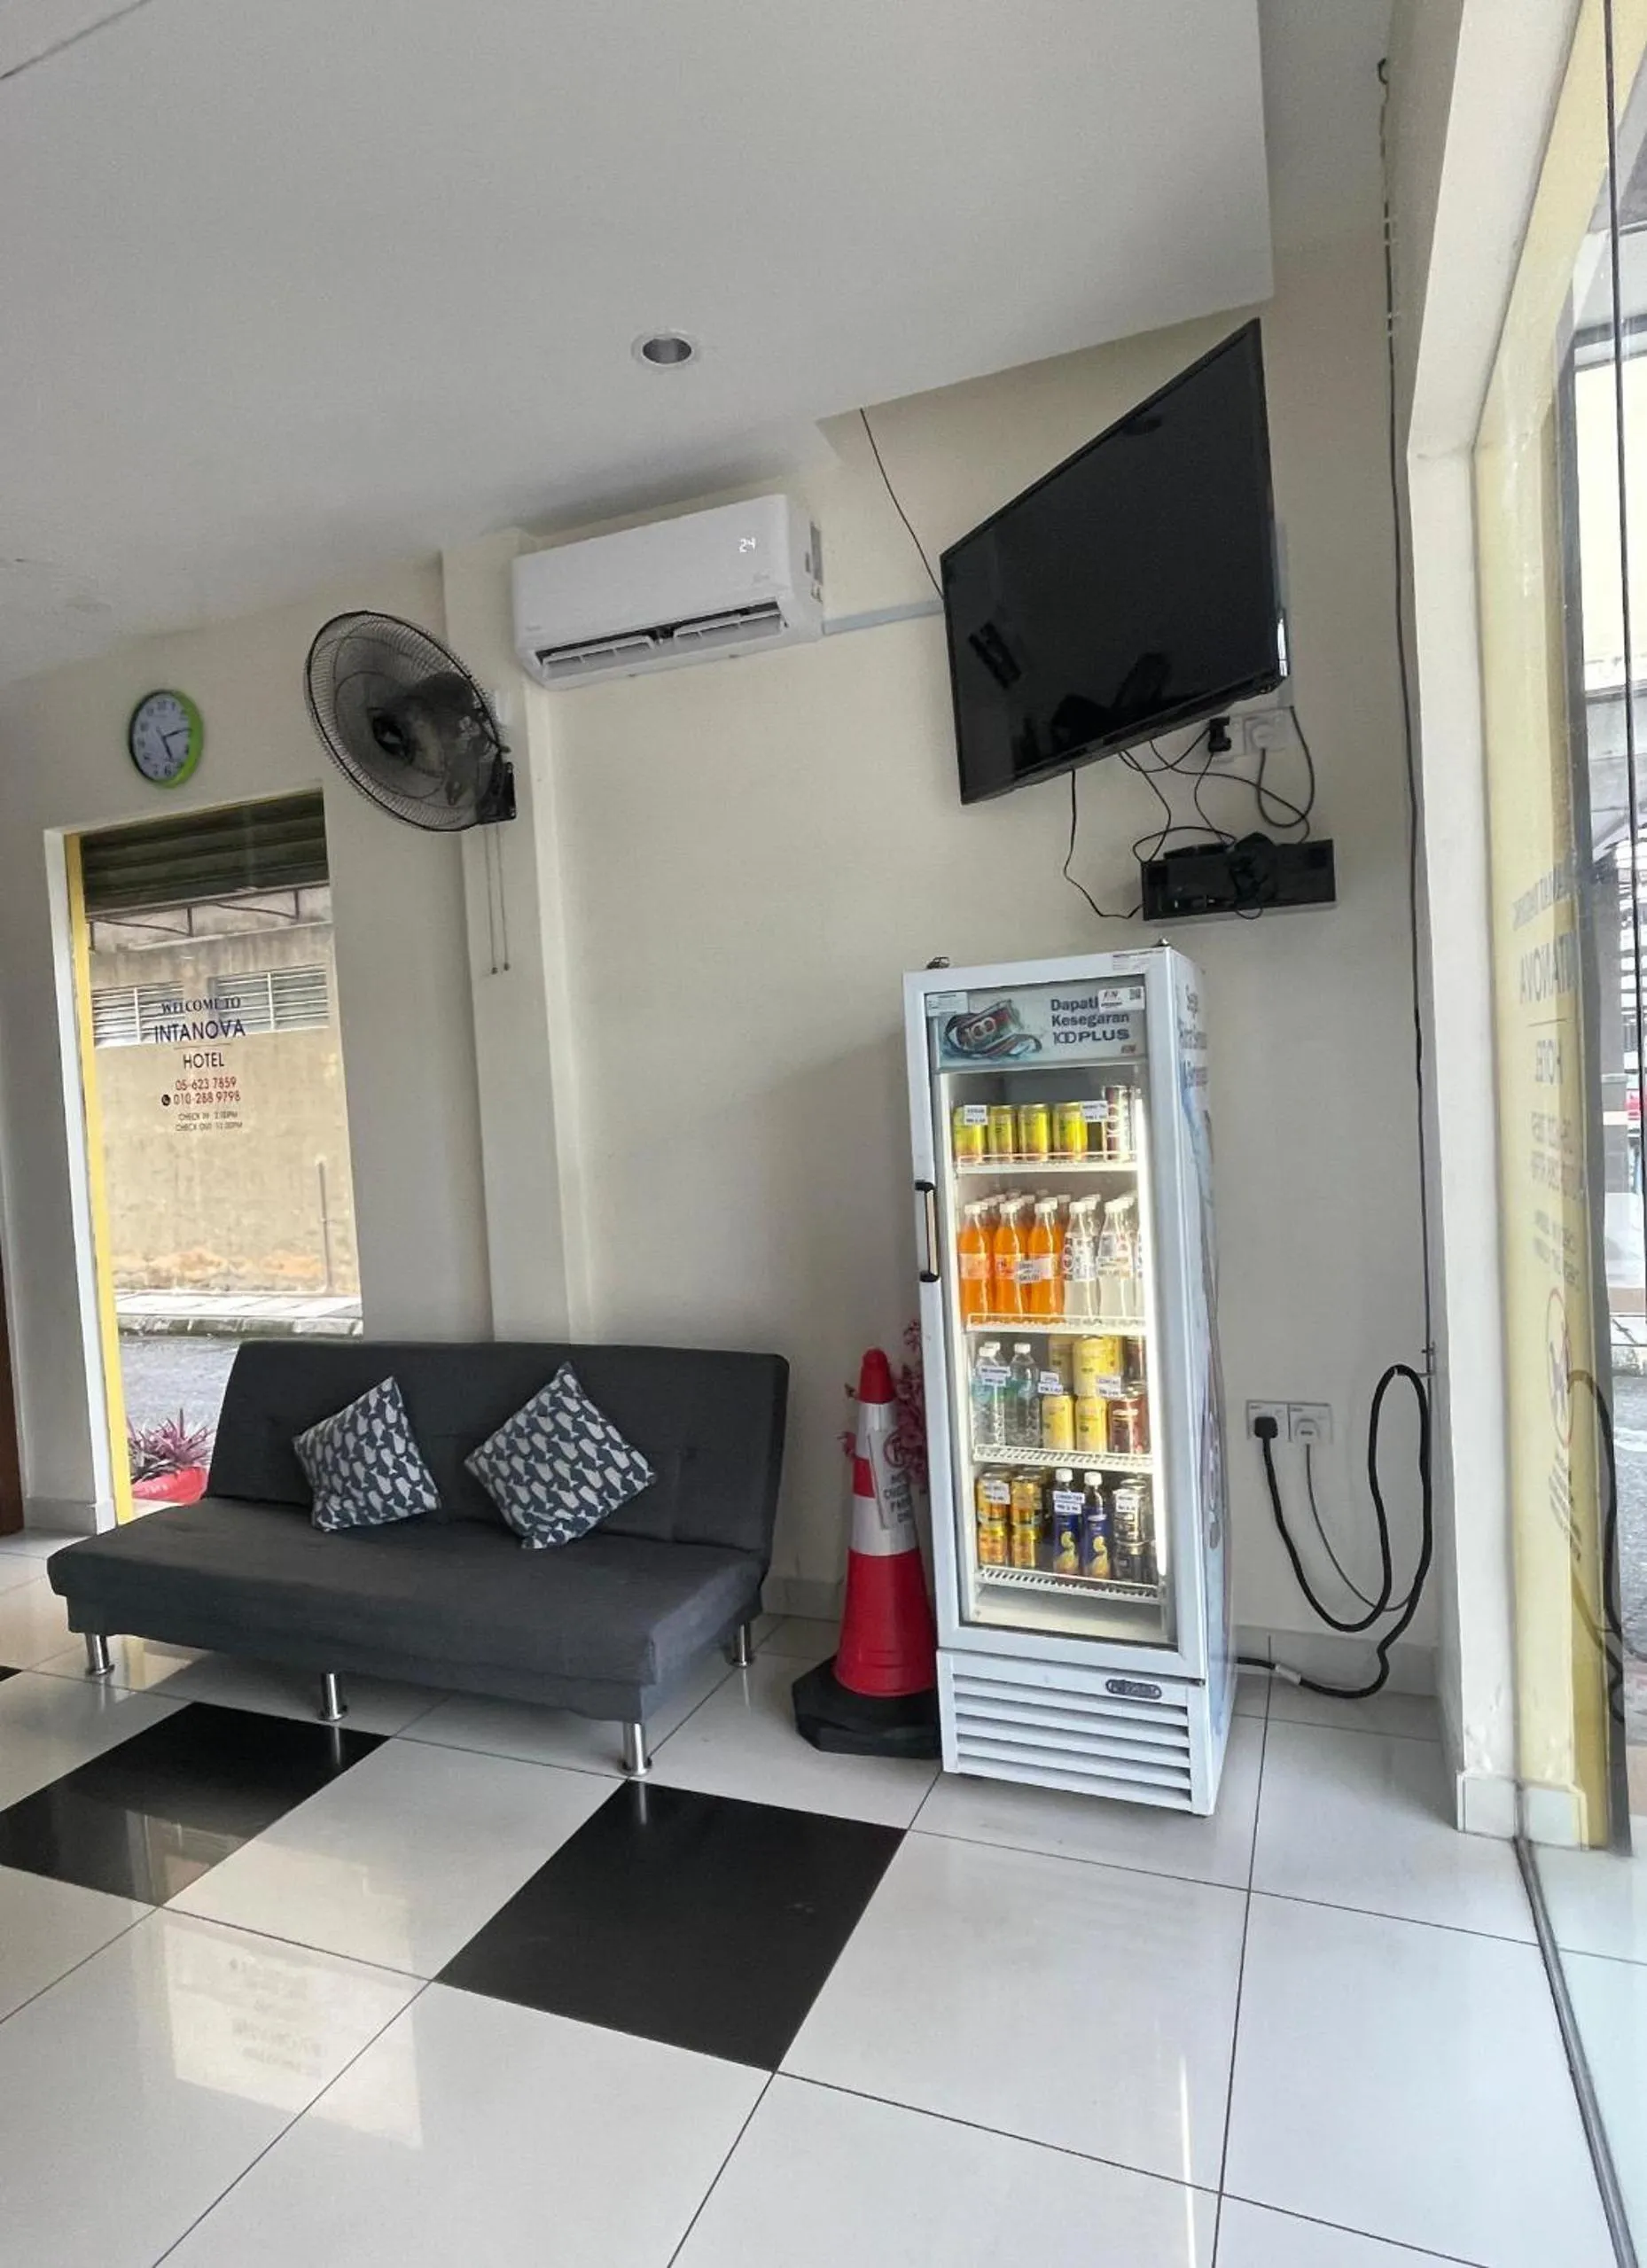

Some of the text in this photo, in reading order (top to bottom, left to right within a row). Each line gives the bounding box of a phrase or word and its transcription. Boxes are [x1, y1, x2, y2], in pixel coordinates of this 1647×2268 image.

[738, 537, 756, 553] 24
[161, 996, 241, 1015] WELCOME TO
[1051, 1013, 1130, 1028] Kesegaran
[153, 1019, 246, 1044] INTANOVA
[183, 1052, 225, 1069] HOTEL
[176, 1078, 209, 1090] 05-623
